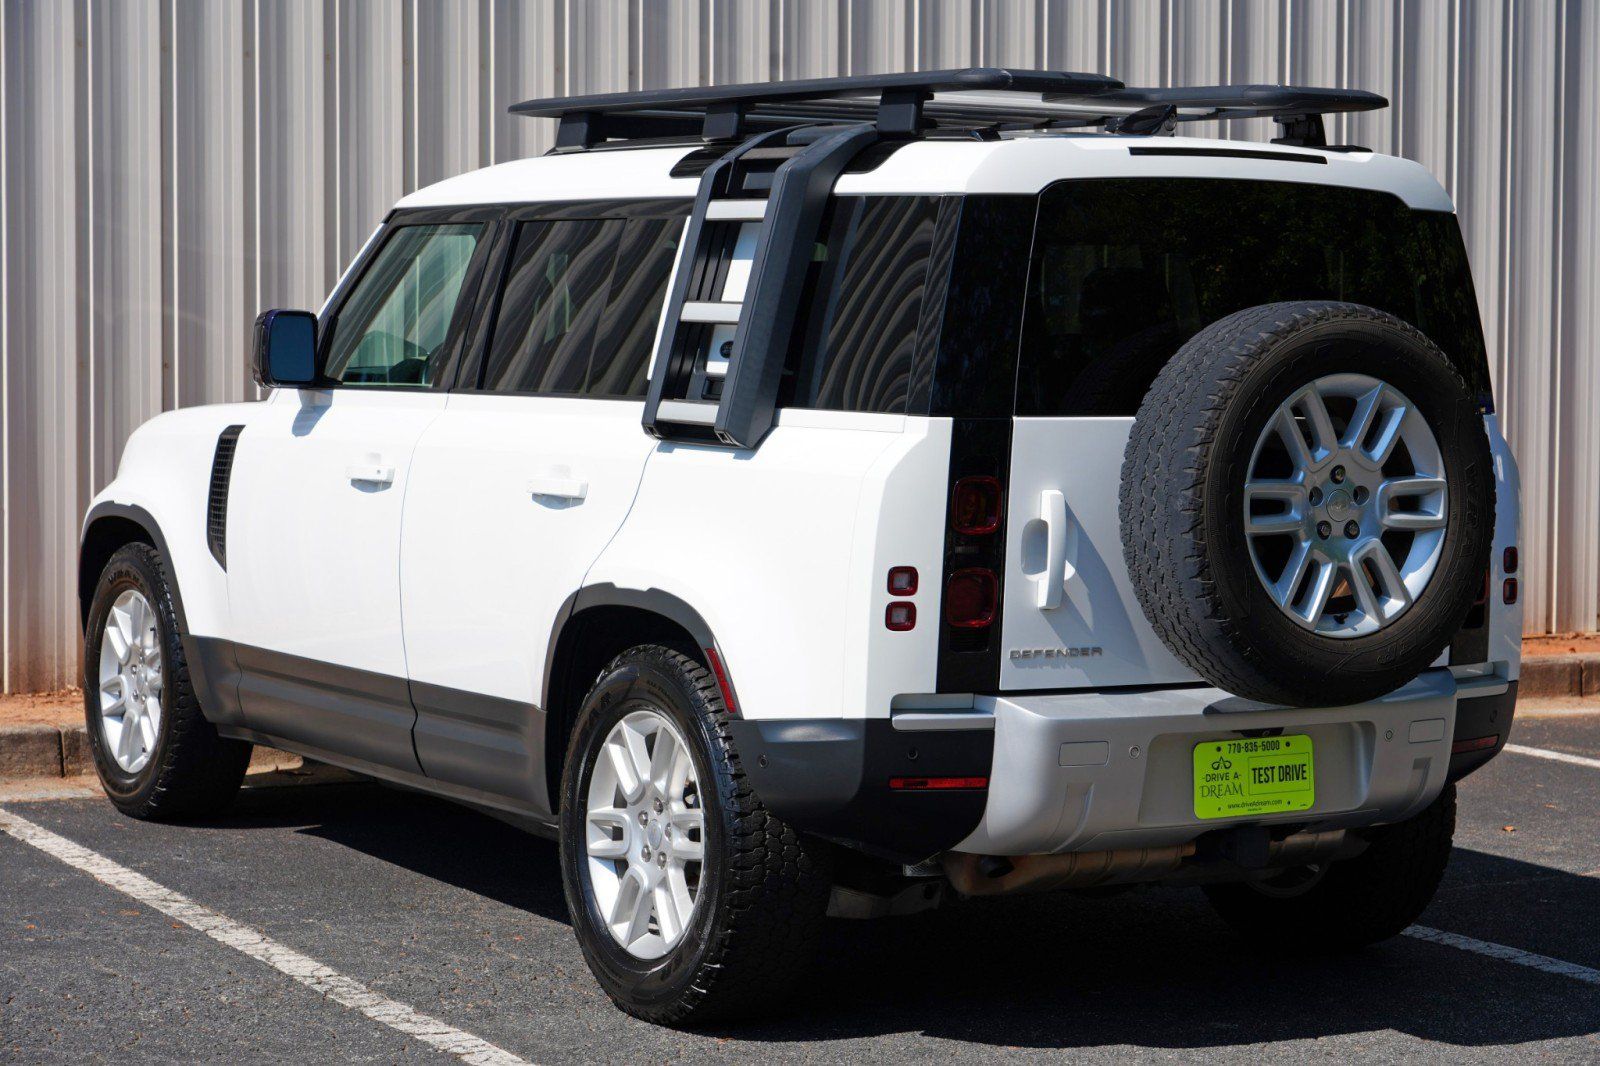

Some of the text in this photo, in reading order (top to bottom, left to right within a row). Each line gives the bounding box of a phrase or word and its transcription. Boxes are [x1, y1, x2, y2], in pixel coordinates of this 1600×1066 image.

[1009, 647, 1103, 660] DEFENDER
[1228, 740, 1280, 754] 770-835-5000
[1205, 772, 1230, 782] DRIVE
[1252, 763, 1307, 784] TEST DRIVE
[1200, 782, 1245, 799] DREAM
